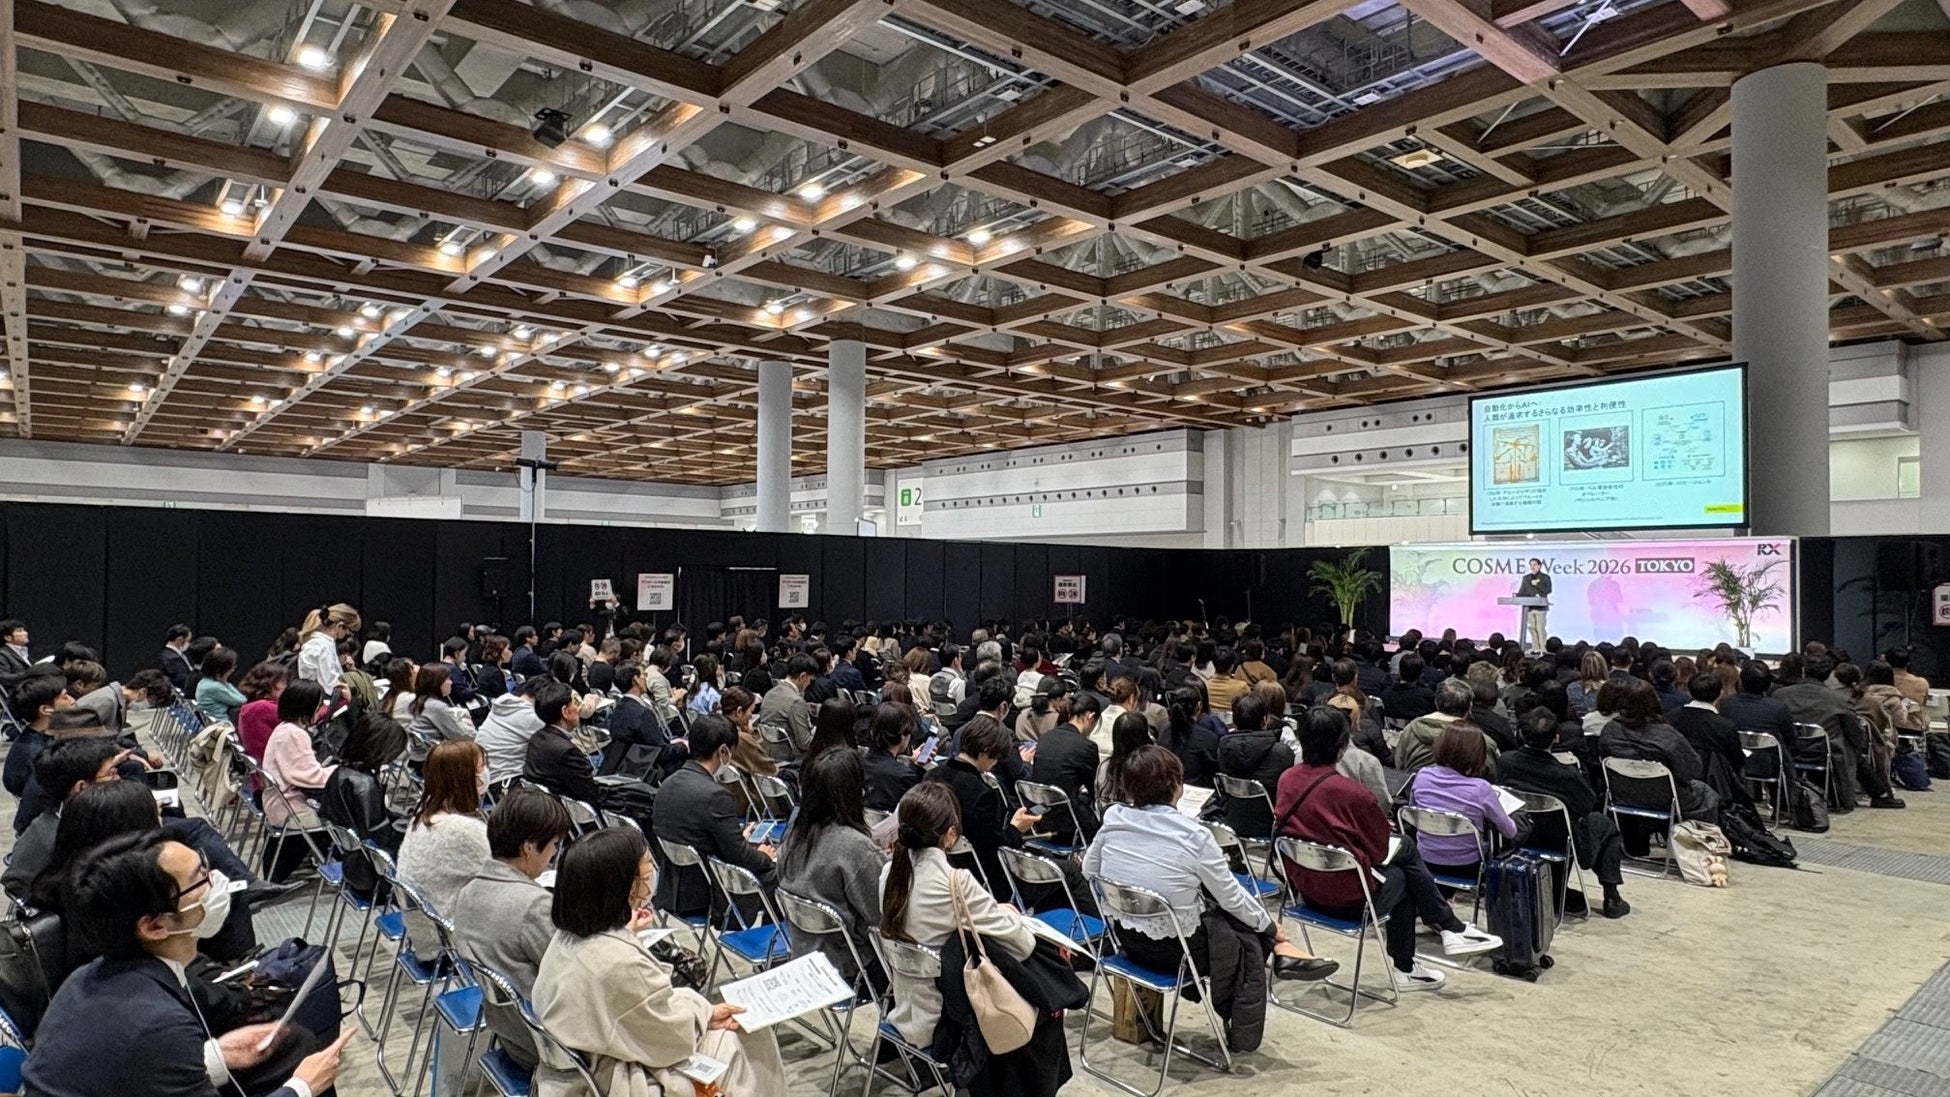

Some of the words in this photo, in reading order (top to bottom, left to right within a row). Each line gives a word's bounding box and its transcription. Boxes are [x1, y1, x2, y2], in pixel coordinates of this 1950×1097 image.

[1484, 401, 1538, 413] 自動化からAIへ
[914, 487, 922, 506] 2
[1757, 543, 1781, 556] RX
[1452, 557, 1525, 575] COSME
[1587, 558, 1631, 575] 2026
[1637, 559, 1694, 573] TOKYO
